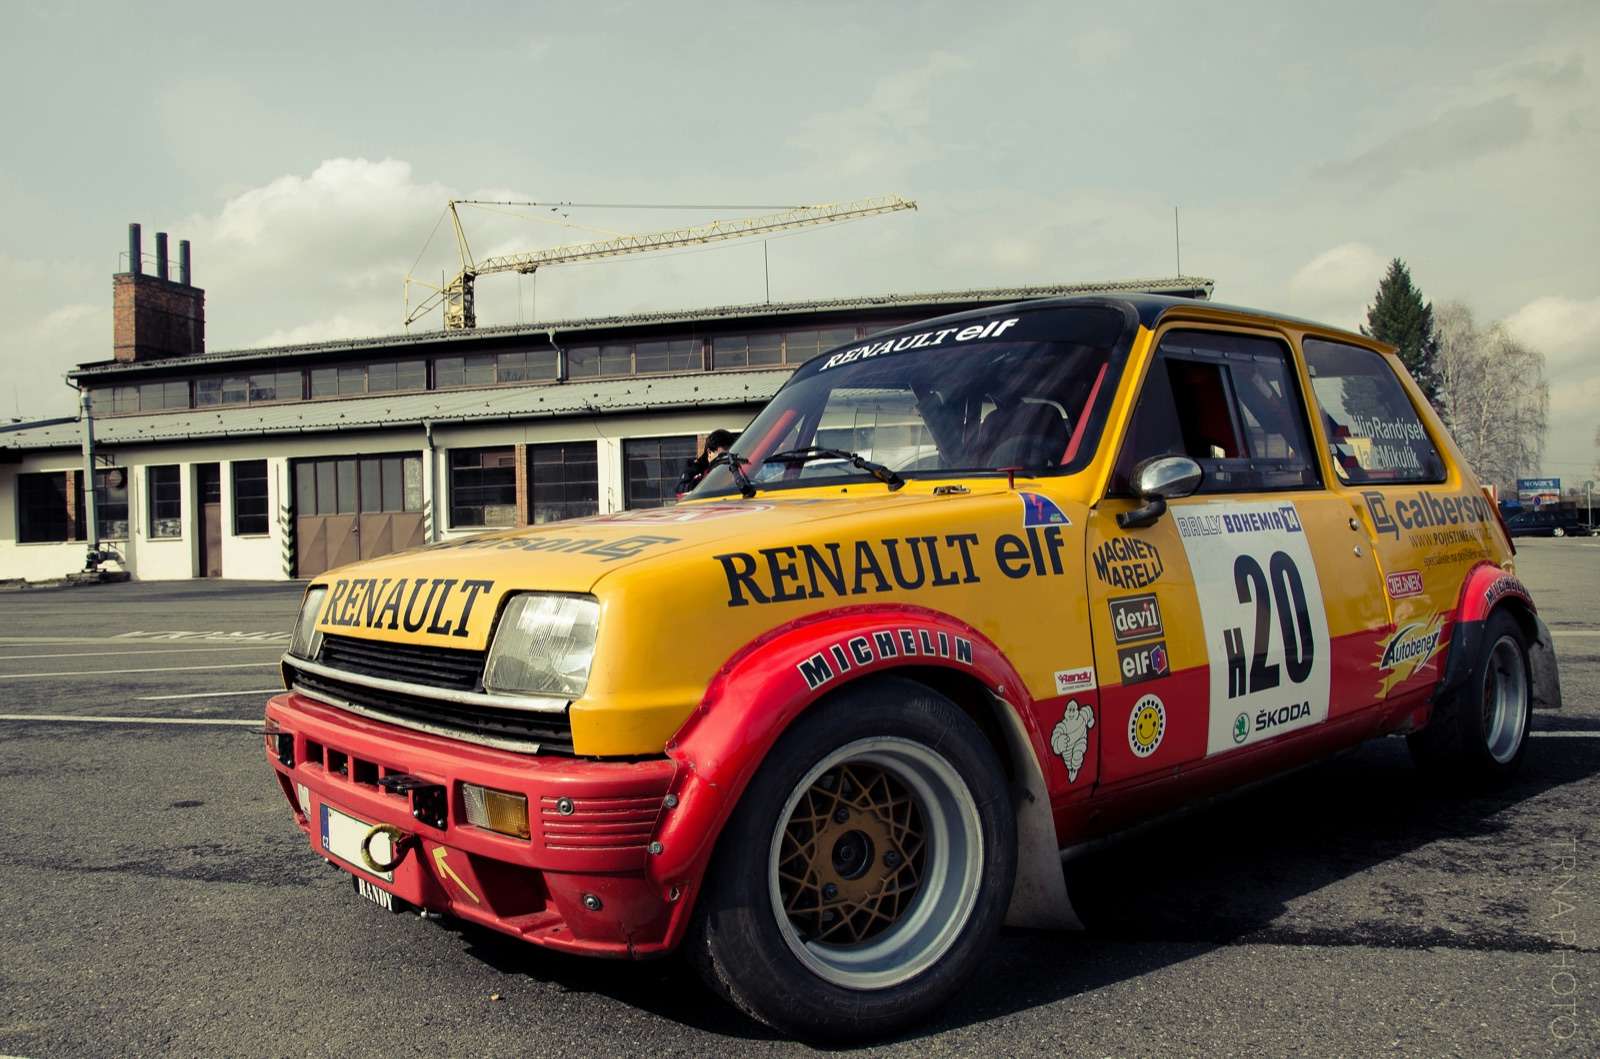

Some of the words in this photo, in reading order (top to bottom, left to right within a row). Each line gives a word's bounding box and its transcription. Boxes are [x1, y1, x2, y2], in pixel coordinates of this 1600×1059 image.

[819, 327, 957, 372] RENAULT
[955, 317, 1020, 342] elf
[1177, 514, 1222, 538] RALLY
[1223, 510, 1284, 534] BOHEMIA
[1395, 490, 1493, 531] calberson
[713, 532, 981, 607] RENAULT
[995, 526, 1065, 579] elf
[321, 578, 494, 638] RENAULT
[1116, 601, 1158, 632] devil
[1233, 550, 1314, 694] 20
[796, 629, 973, 691] MICHELIN
[1122, 651, 1150, 677] elf
[1223, 627, 1246, 699] H
[1255, 700, 1311, 732] ŠKODA
